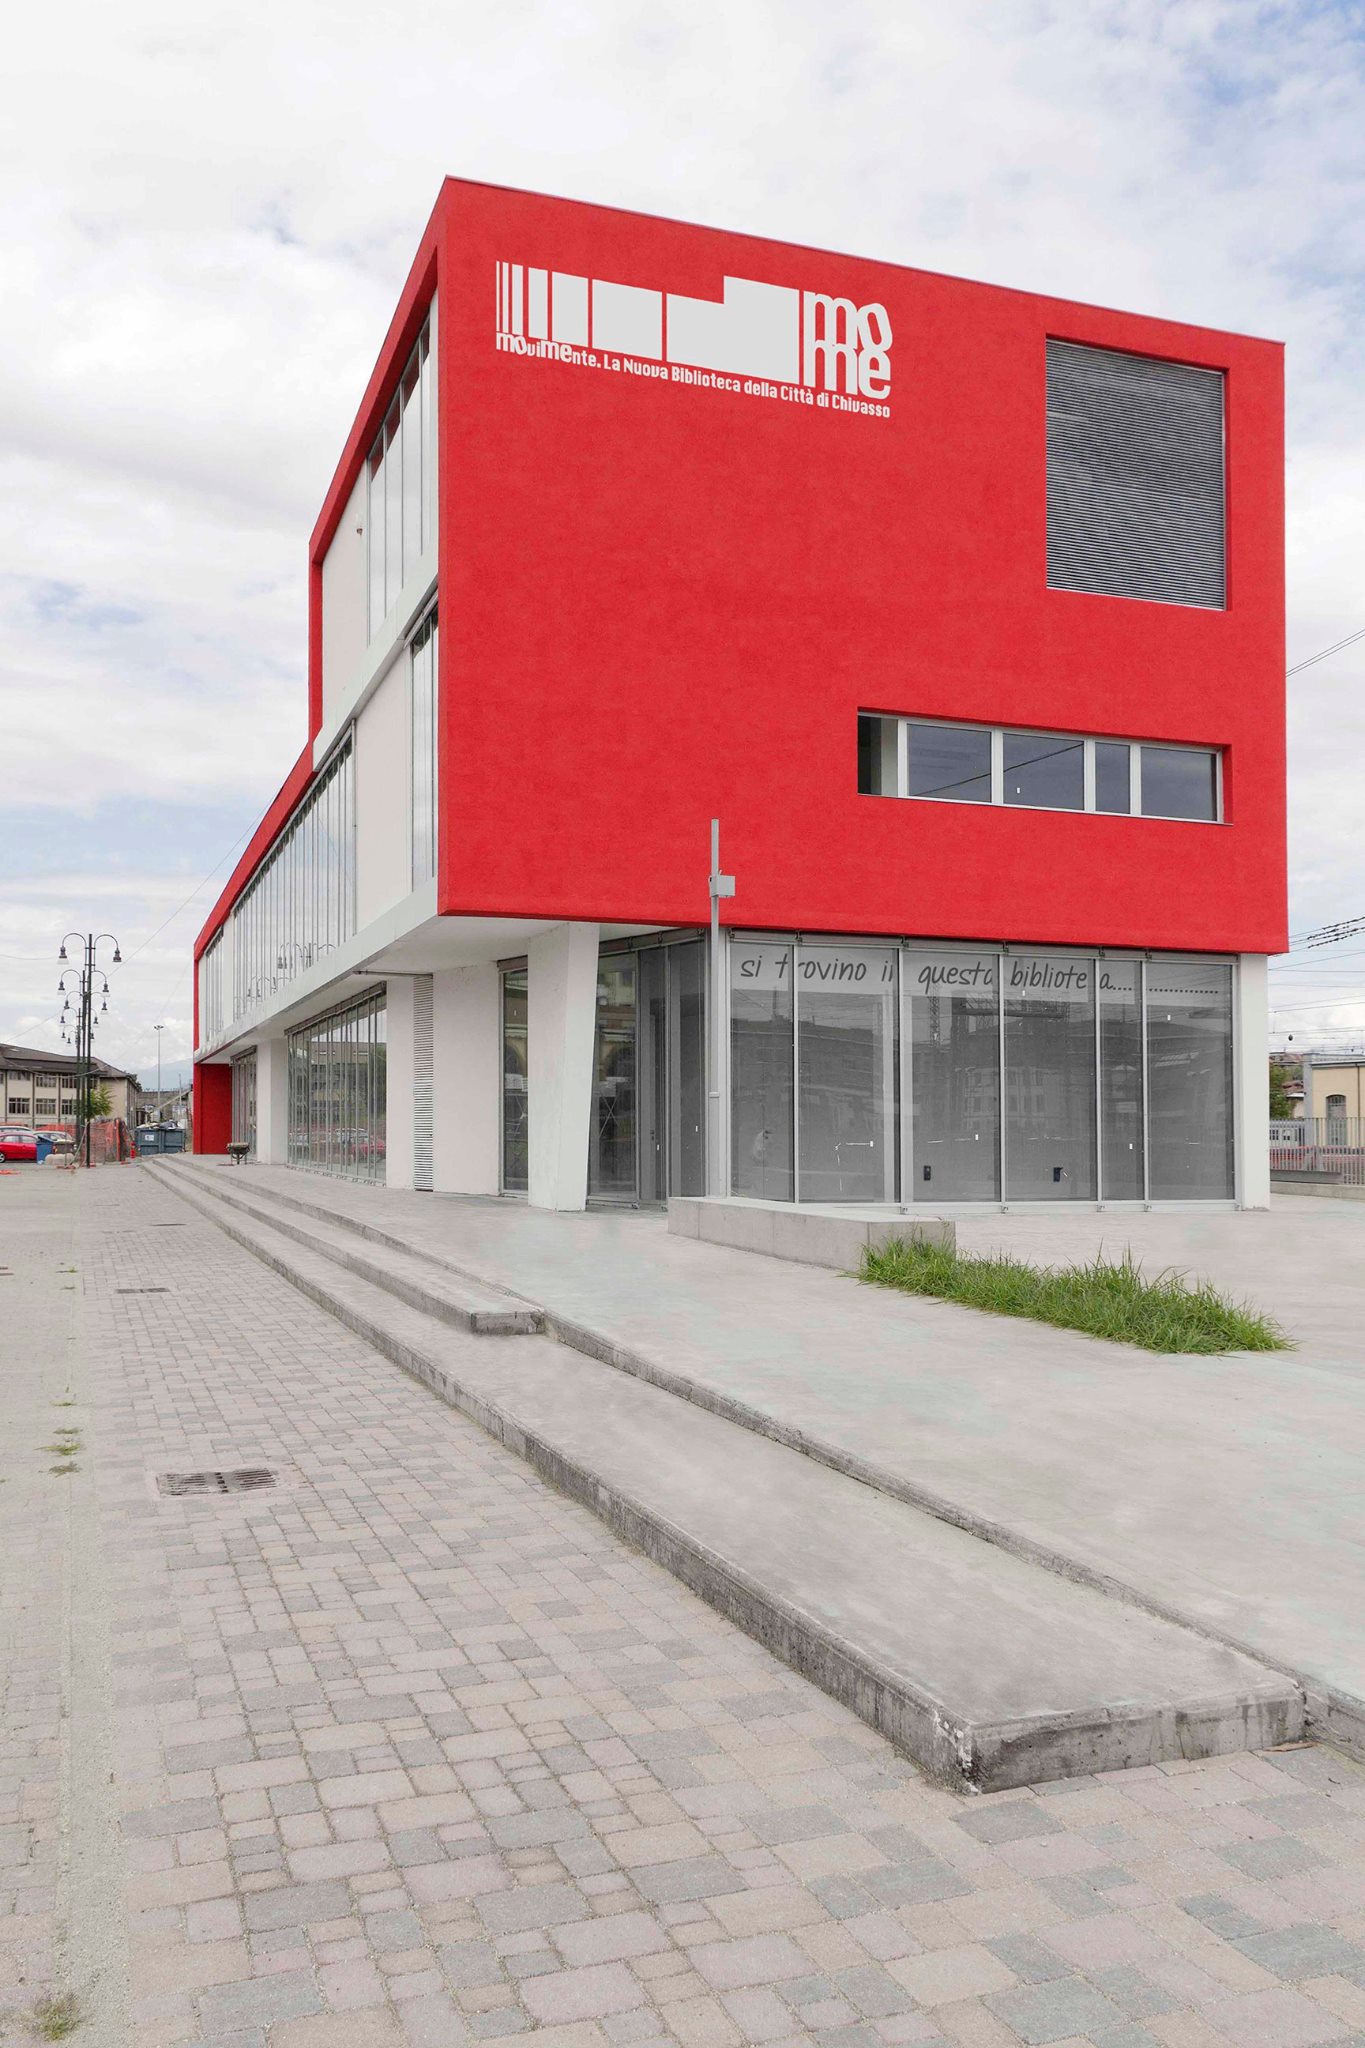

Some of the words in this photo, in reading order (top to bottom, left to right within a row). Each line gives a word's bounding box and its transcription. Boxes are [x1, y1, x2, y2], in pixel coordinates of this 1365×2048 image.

[803, 290, 893, 352] mo
[603, 353, 621, 372] La
[623, 357, 669, 380] Nuova
[671, 365, 741, 393] Biblioteca
[744, 379, 778, 399] della
[780, 385, 814, 406] Città
[816, 391, 830, 408] di
[831, 394, 891, 418] Chivasso
[803, 339, 892, 399] me
[740, 954, 763, 978] si
